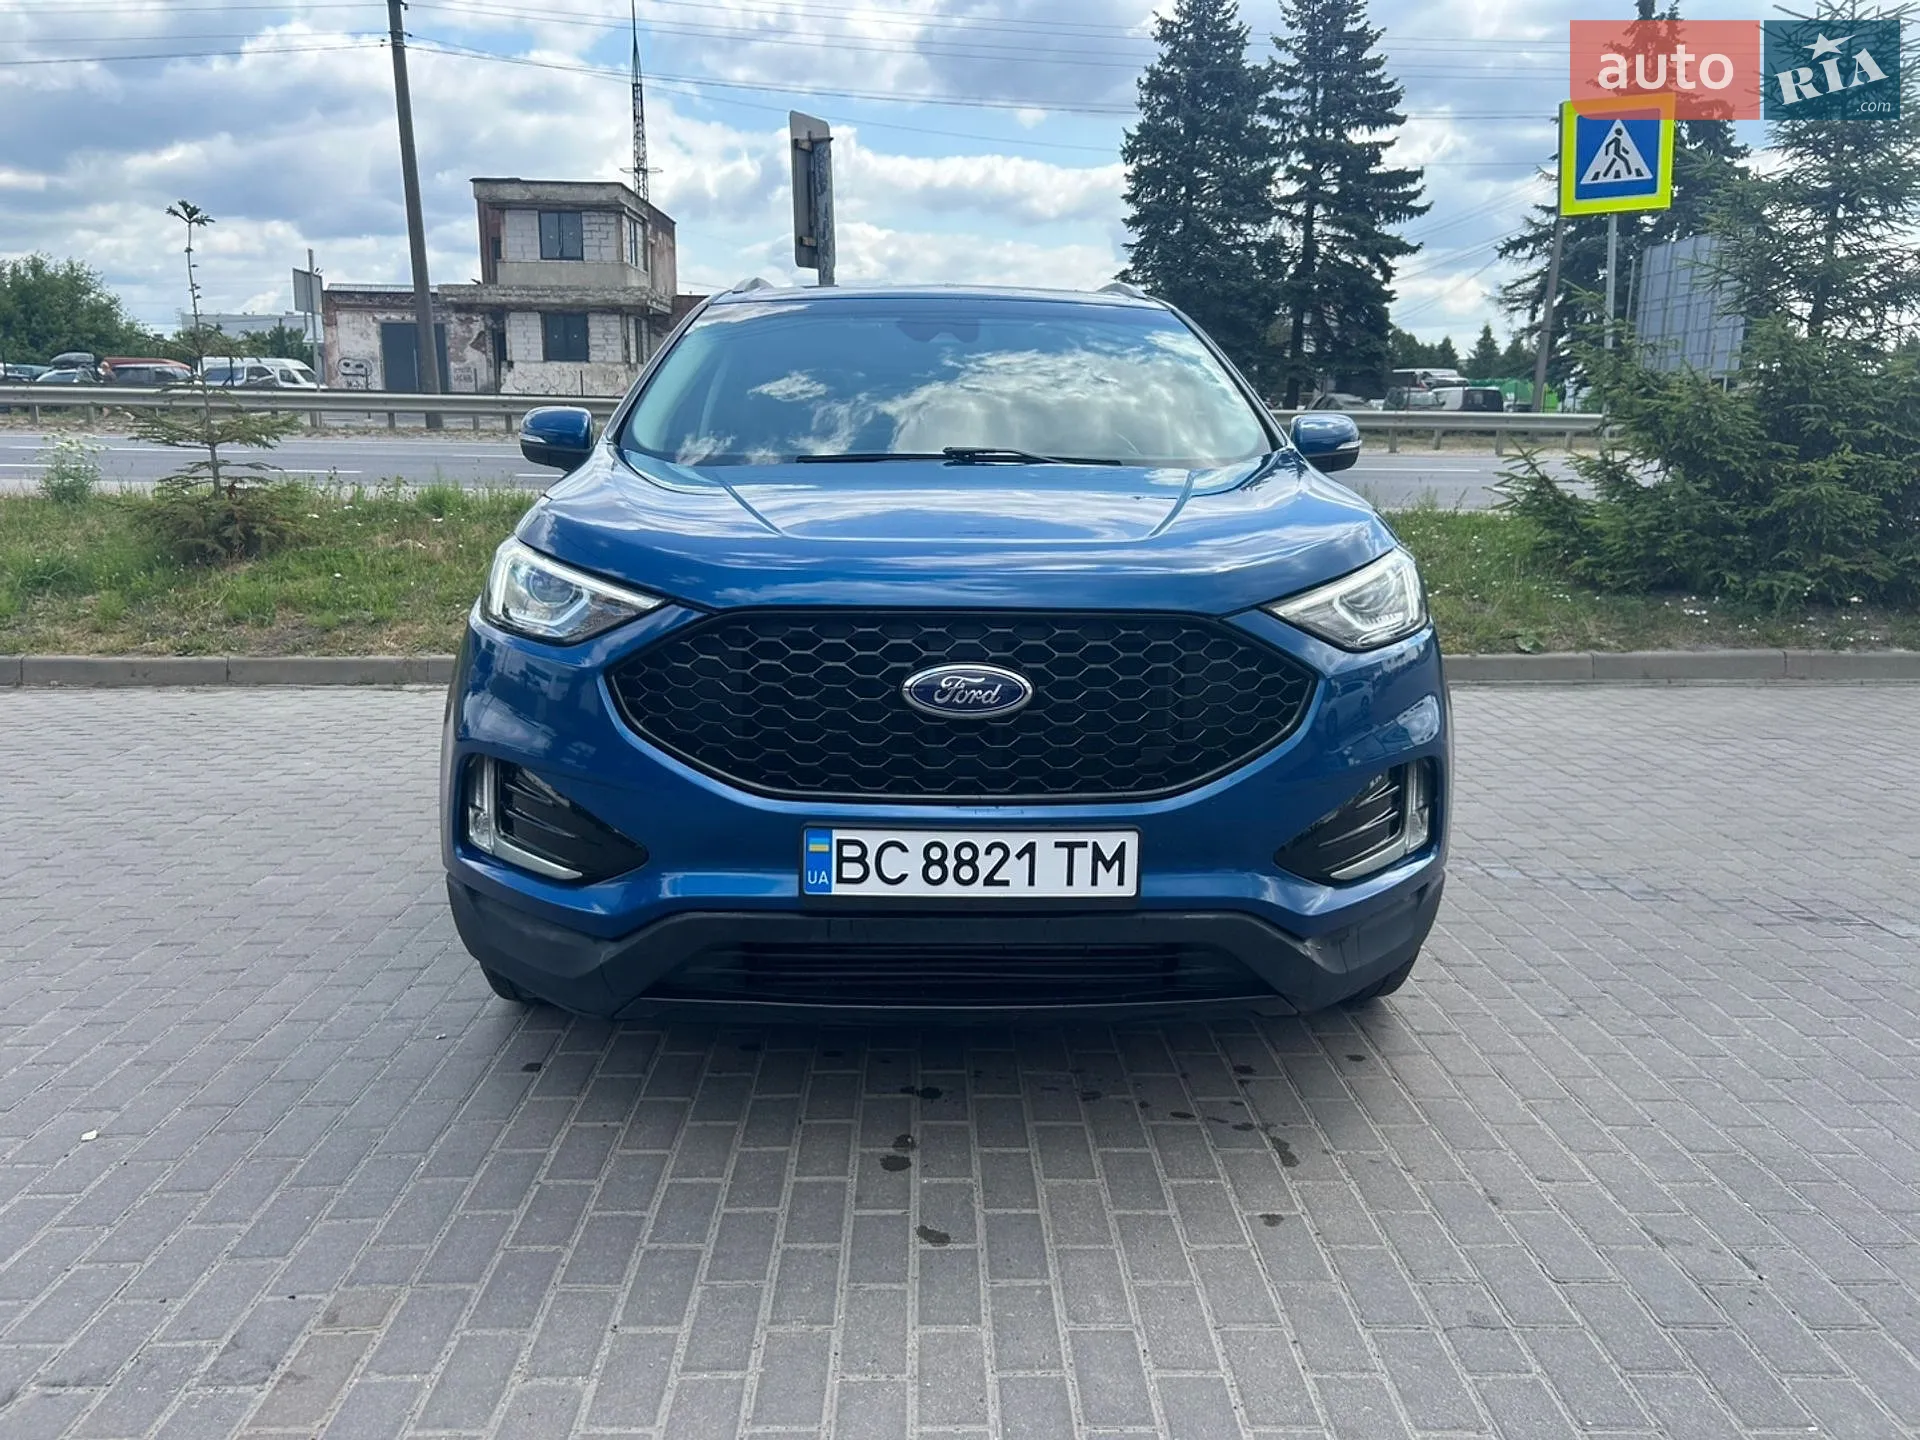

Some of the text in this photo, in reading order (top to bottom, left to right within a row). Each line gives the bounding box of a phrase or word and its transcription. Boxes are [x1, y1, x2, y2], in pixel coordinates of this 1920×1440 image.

[934, 675, 1002, 704] Ford
[807, 870, 829, 884] UA
[835, 839, 1127, 887] BC 8821 TM
